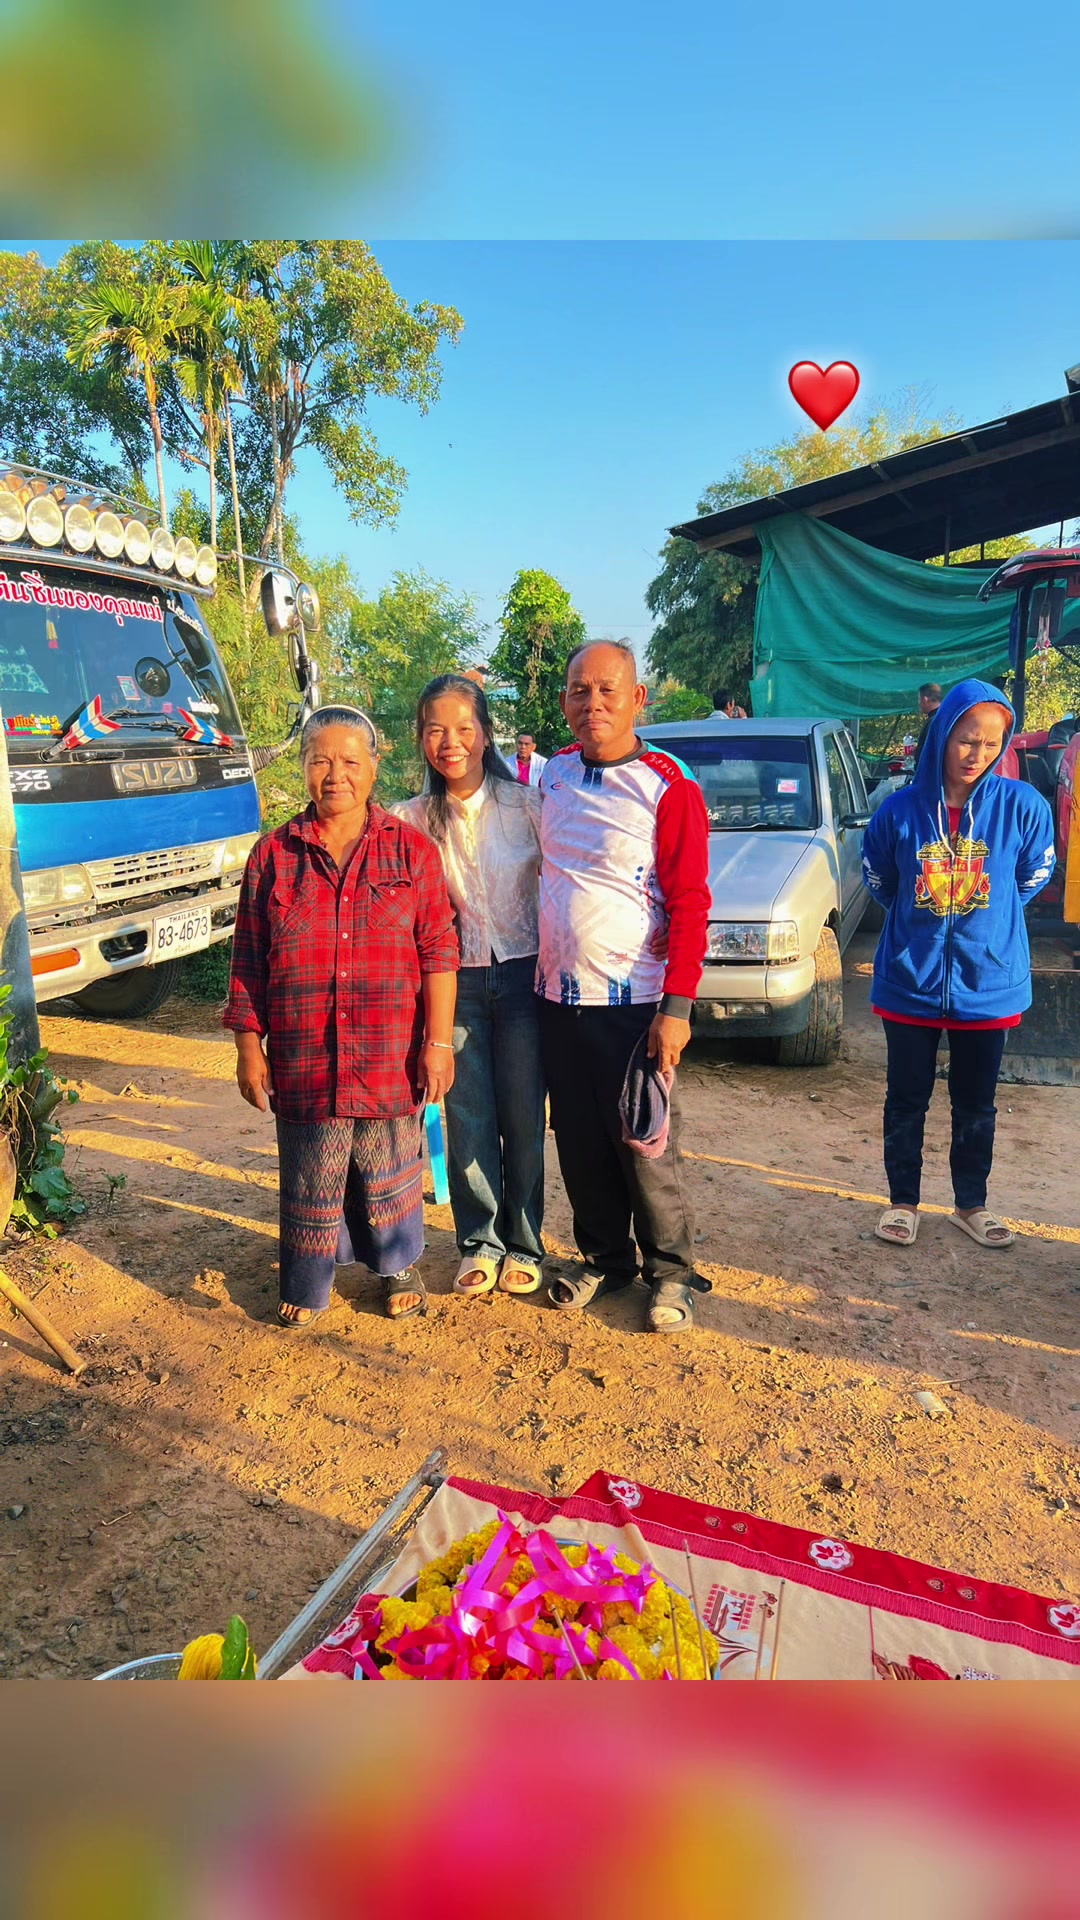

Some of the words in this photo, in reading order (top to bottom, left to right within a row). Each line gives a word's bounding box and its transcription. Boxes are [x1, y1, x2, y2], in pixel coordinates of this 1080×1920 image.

[112, 760, 196, 790] ISUZU
[169, 910, 199, 923] THAILAND
[158, 916, 208, 949] 83-4673
